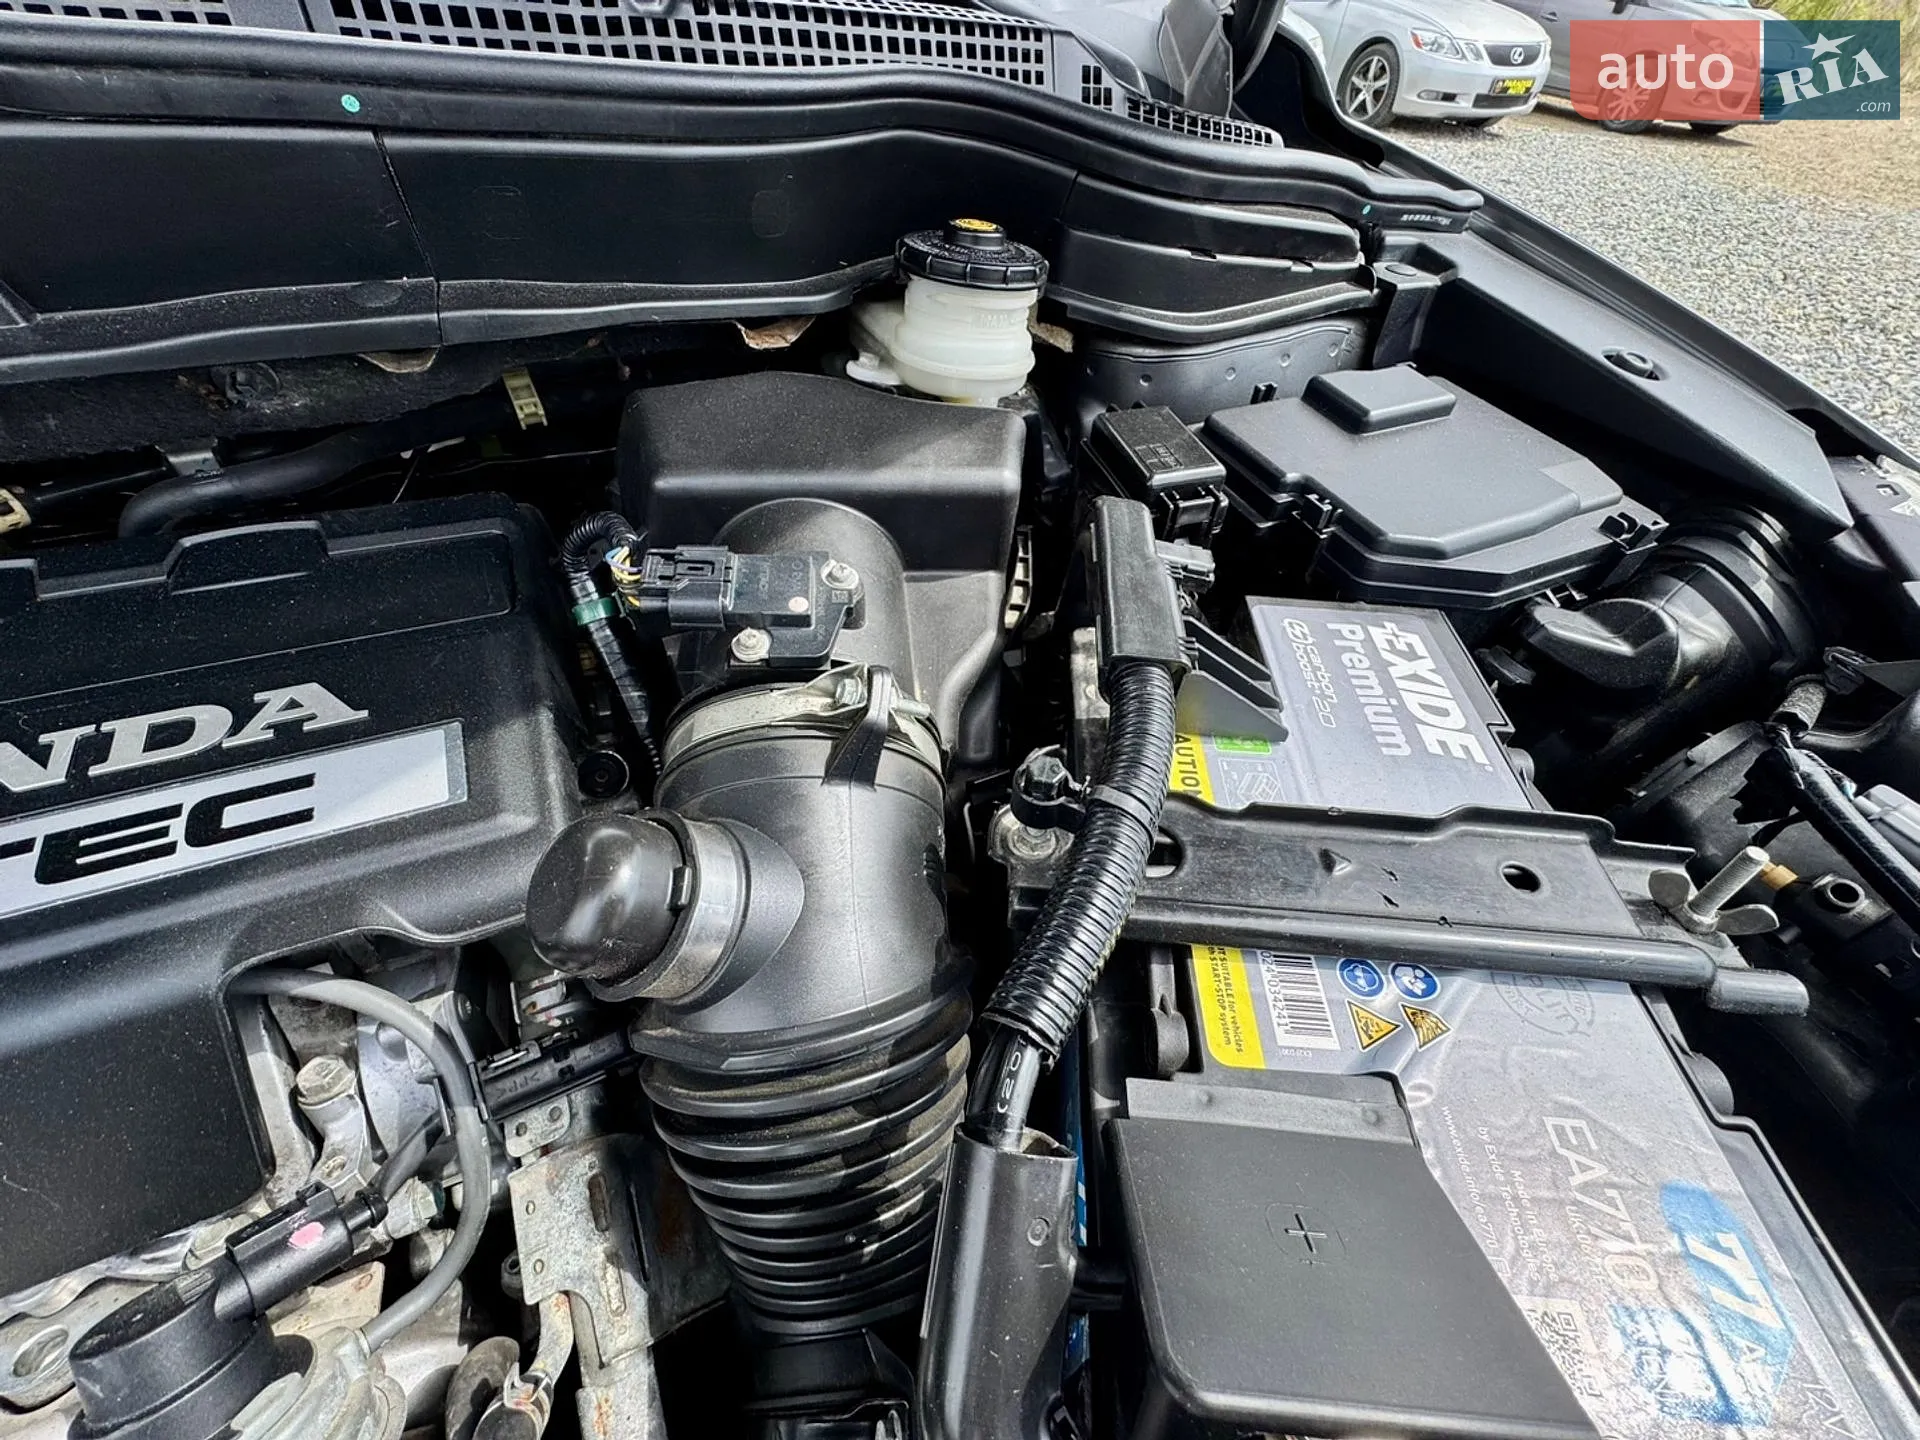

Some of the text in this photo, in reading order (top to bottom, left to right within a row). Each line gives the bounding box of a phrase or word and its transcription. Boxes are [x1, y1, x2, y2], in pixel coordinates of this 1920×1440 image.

[1292, 643, 1321, 692] boost
[1306, 645, 1338, 704] carbon
[1327, 623, 1411, 756] Premium
[1366, 621, 1490, 767] EXIDE
[0, 773, 316, 885] EC
[1209, 955, 1228, 1009] START-STOP
[1218, 955, 1234, 998] SUITABLE
[1227, 999, 1235, 1010] for
[1231, 1011, 1244, 1053] vehicles
[1218, 1011, 1232, 1046] system
[1268, 979, 1290, 1028] 034241
[1440, 1105, 1499, 1249] www.exide.info/ea770
[1476, 1125, 1541, 1282] by Exide Technologies
[1510, 1169, 1560, 1282] Made in Europe
[1685, 1231, 1786, 1330] 77
